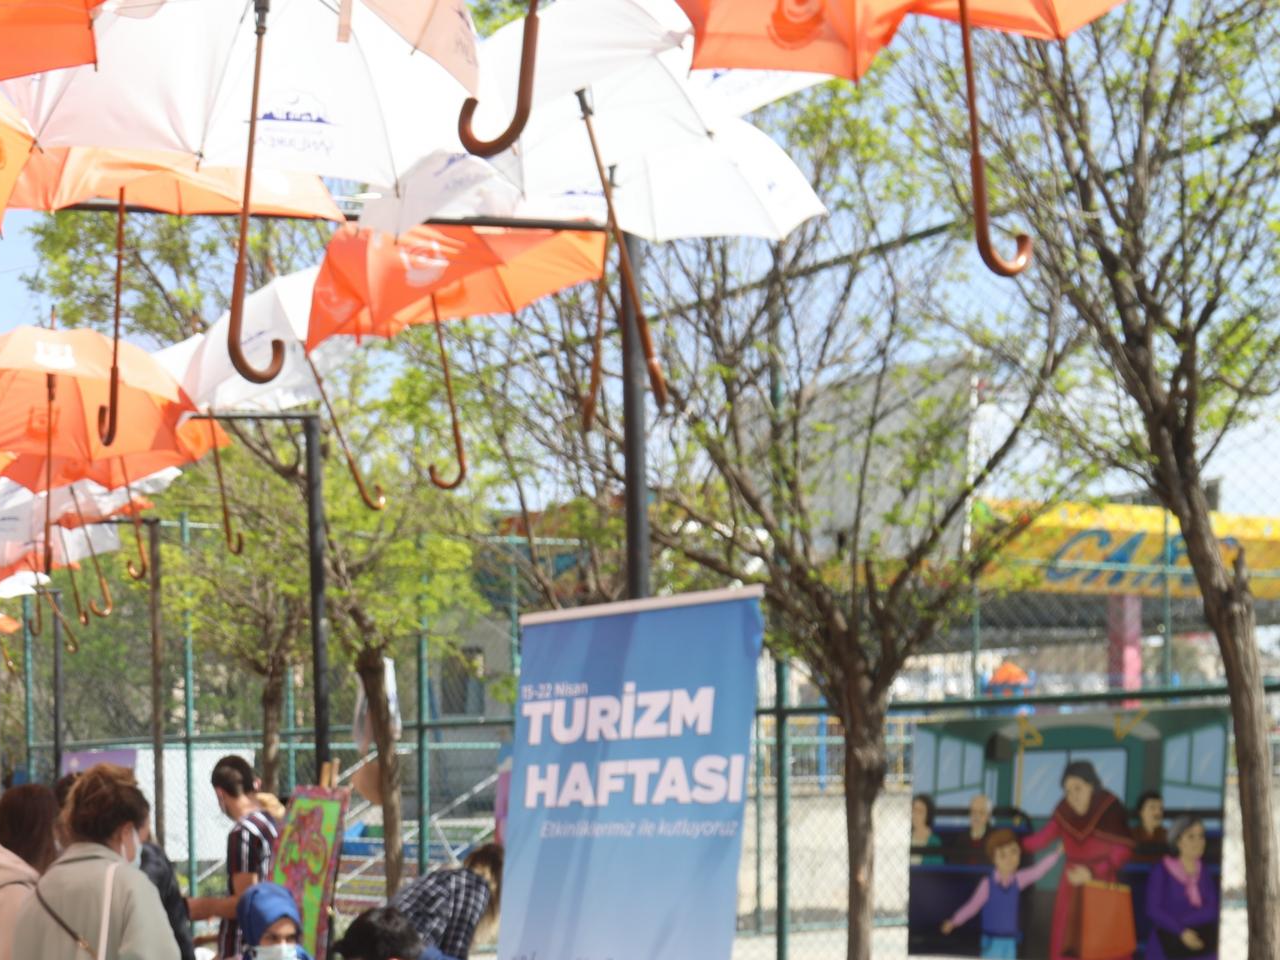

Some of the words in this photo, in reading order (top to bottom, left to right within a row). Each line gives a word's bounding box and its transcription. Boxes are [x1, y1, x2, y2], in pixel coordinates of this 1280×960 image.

[554, 681, 588, 697] Nisan
[522, 681, 716, 746] TURİZM
[524, 754, 745, 809] HAFTASI
[658, 818, 738, 839] kutluyoruz
